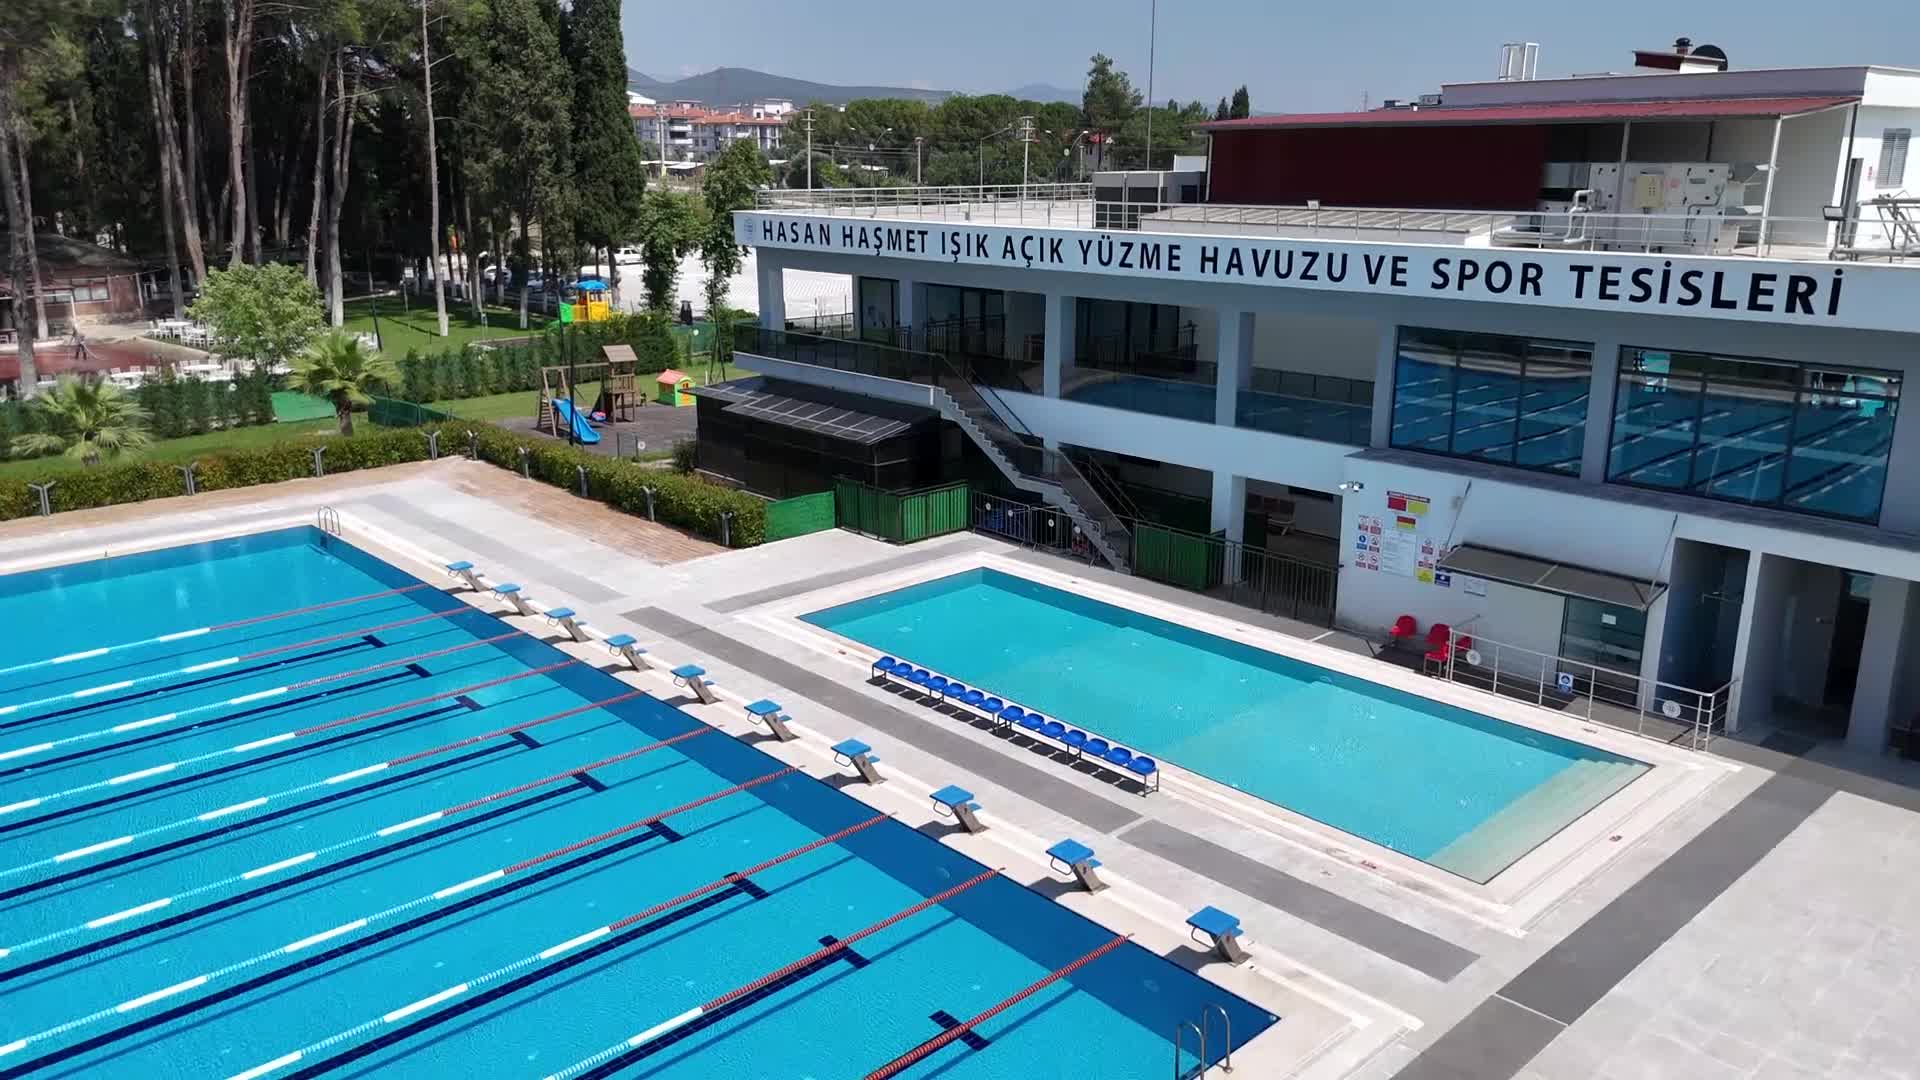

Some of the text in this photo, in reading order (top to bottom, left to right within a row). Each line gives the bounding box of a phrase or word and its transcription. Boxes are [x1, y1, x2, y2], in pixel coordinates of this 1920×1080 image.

[762, 218, 1844, 316] HASAN HAŞMET IŞIK AÇIK YÜZME HAVUZU VE SPOR TESİSLERİ
